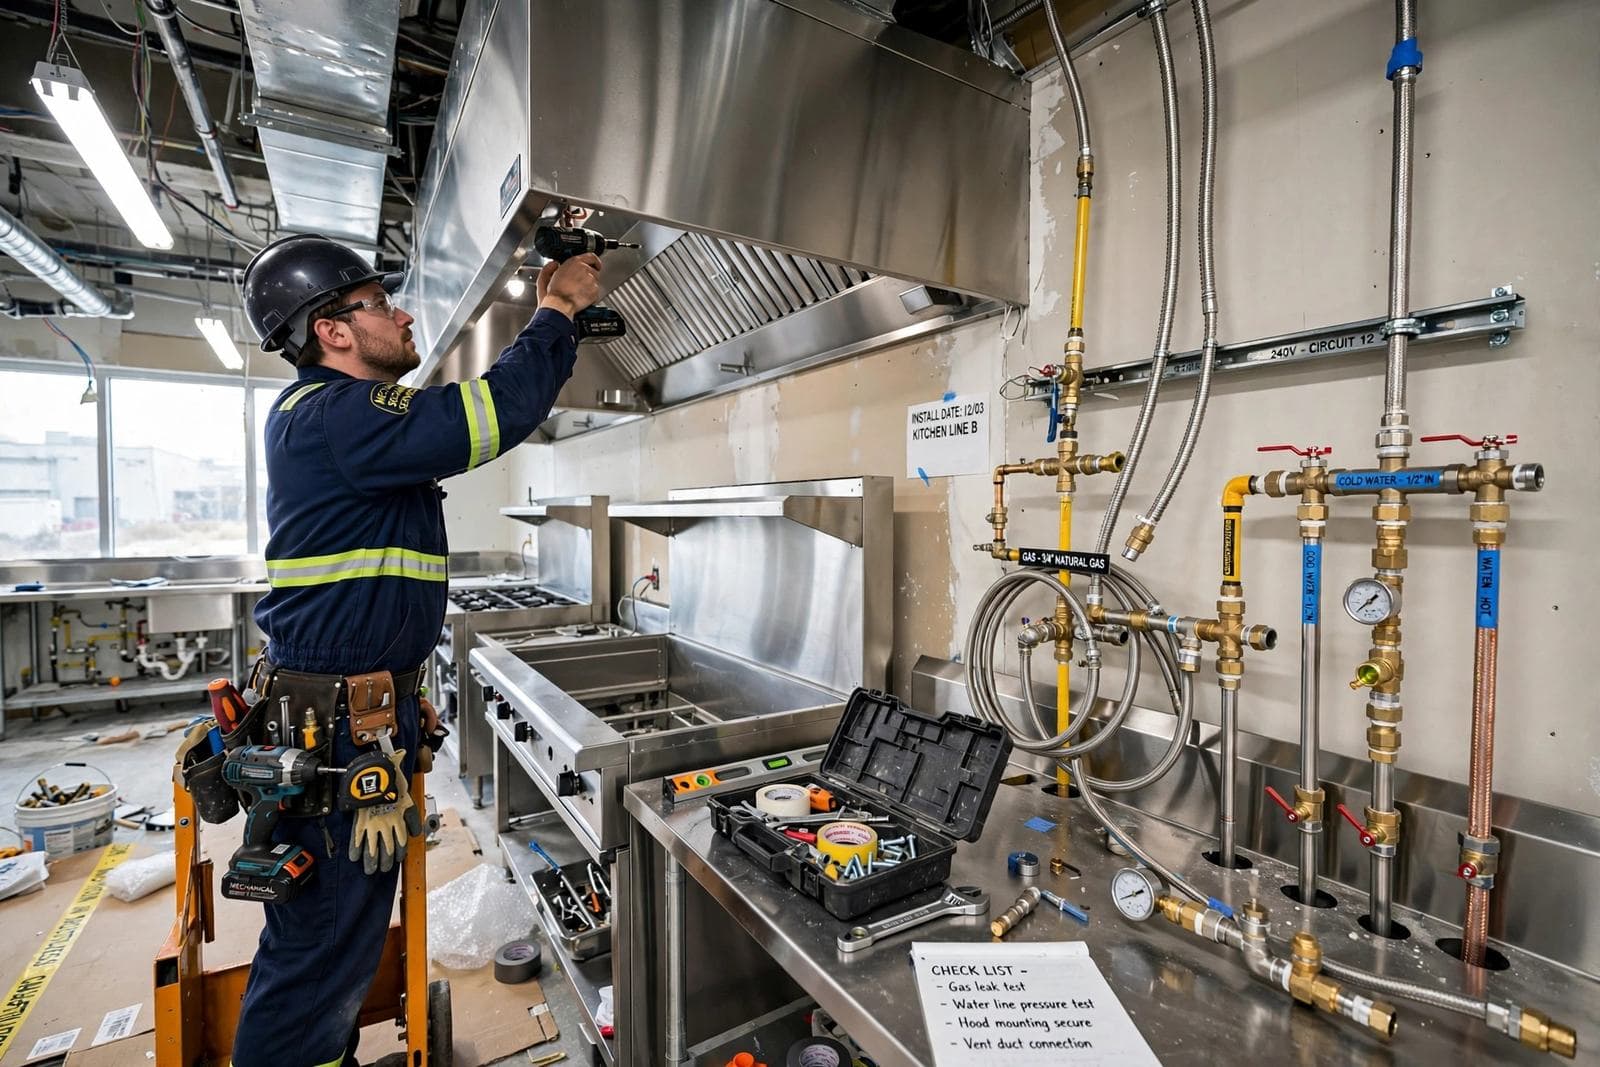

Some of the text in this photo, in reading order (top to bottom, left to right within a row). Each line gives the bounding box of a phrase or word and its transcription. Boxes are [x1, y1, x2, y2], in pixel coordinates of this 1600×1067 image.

[1271, 346, 1297, 360] 240V
[1310, 337, 1356, 353] CIRCUIT
[1360, 334, 1374, 345] 12
[912, 402, 985, 424] INSTALL DATE: 12/03
[913, 420, 978, 440] KITCHEN LINE B
[1339, 477, 1363, 486] COLD
[1365, 475, 1397, 485] WATER
[1424, 475, 1434, 484] IN
[1022, 552, 1036, 562] GAS
[1055, 554, 1088, 568] NATURAL
[1089, 558, 1105, 569] GAS
[1480, 597, 1492, 617] HOT
[931, 965, 980, 976] CHECK
[983, 965, 1014, 976] LIST
[948, 981, 971, 992] Gas
[975, 980, 1000, 991] leak
[1003, 981, 1026, 992] test
[952, 999, 990, 1010] Water
[993, 999, 1016, 1009] line
[1020, 1001, 1067, 1012] pressure
[1071, 998, 1095, 1009] test
[958, 1016, 990, 1028] Hood
[995, 1018, 1050, 1032] mounting
[1054, 1020, 1093, 1028] secure
[963, 1037, 992, 1050] Vent
[997, 1038, 1023, 1049] duct
[1029, 1037, 1093, 1049] connection
